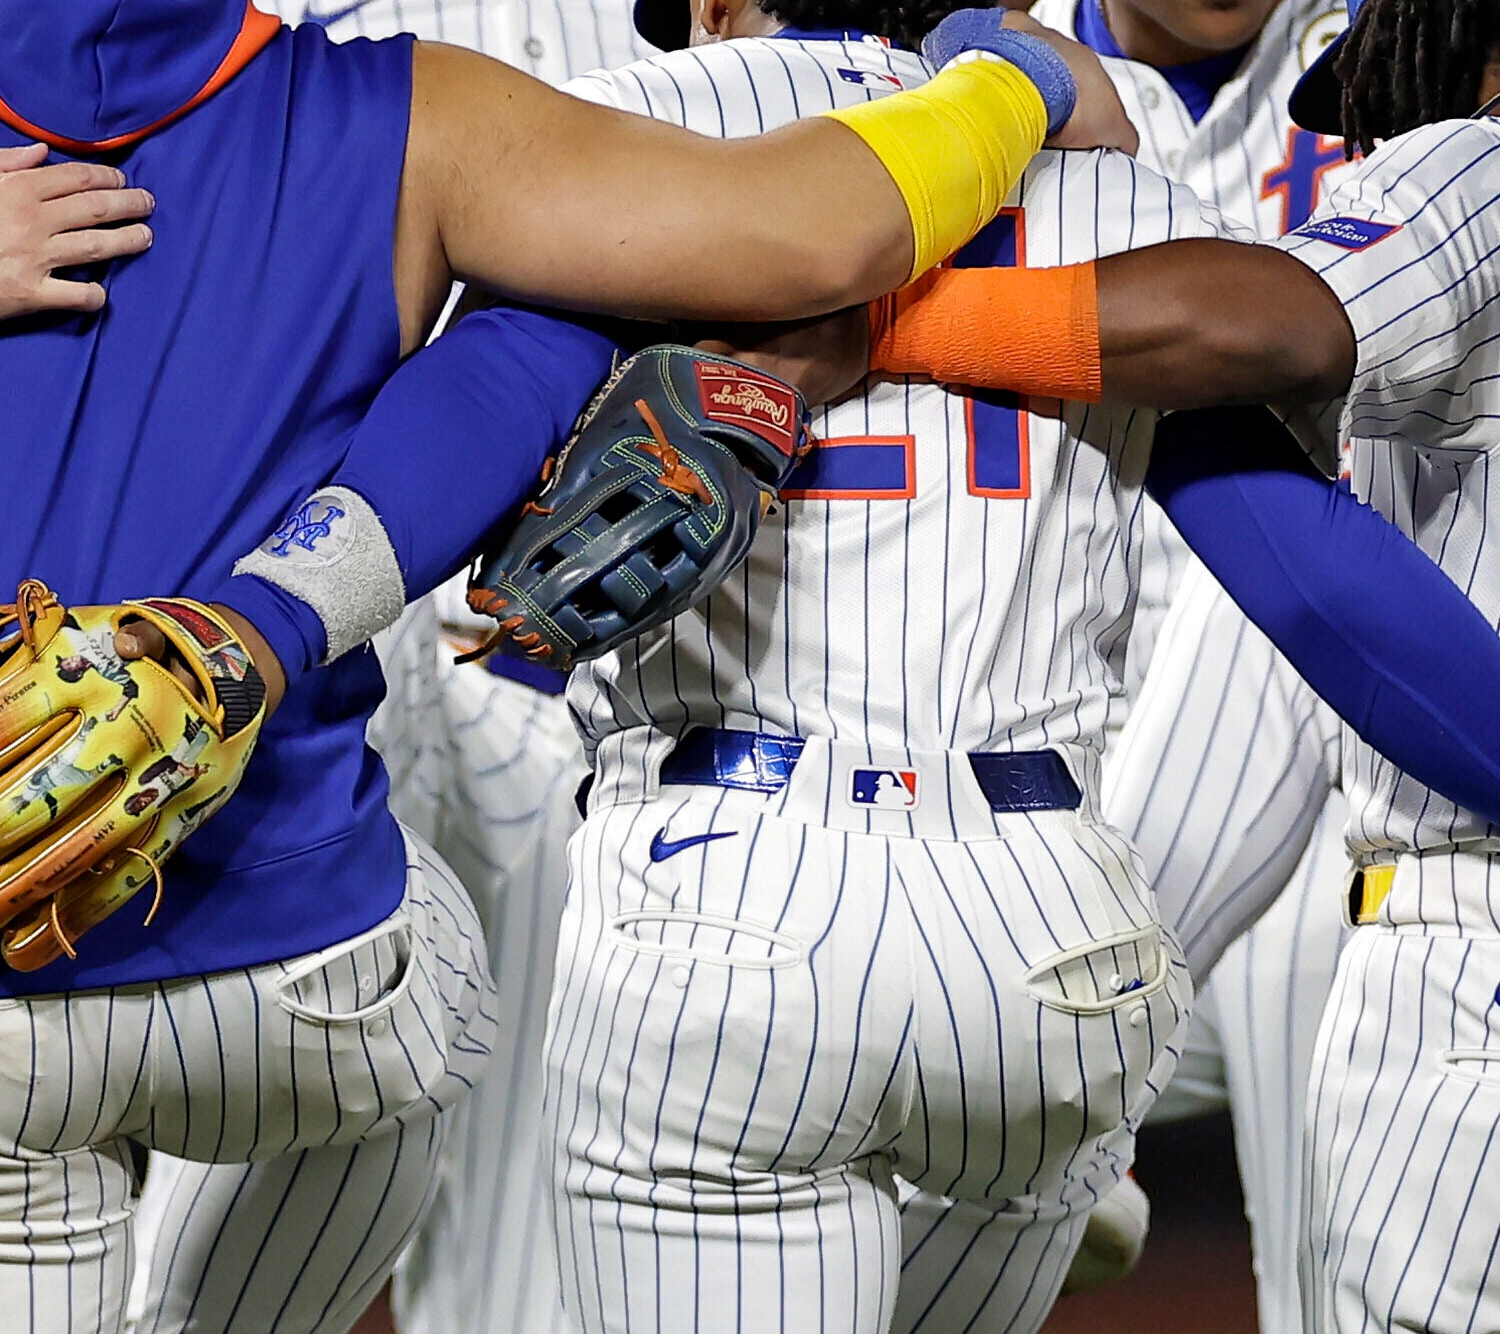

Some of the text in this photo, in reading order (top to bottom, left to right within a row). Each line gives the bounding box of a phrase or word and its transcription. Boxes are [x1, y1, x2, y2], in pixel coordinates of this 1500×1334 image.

[710, 385, 789, 426] Rawlings
[4, 680, 38, 706] Pirates
[92, 820, 117, 843] MVP
